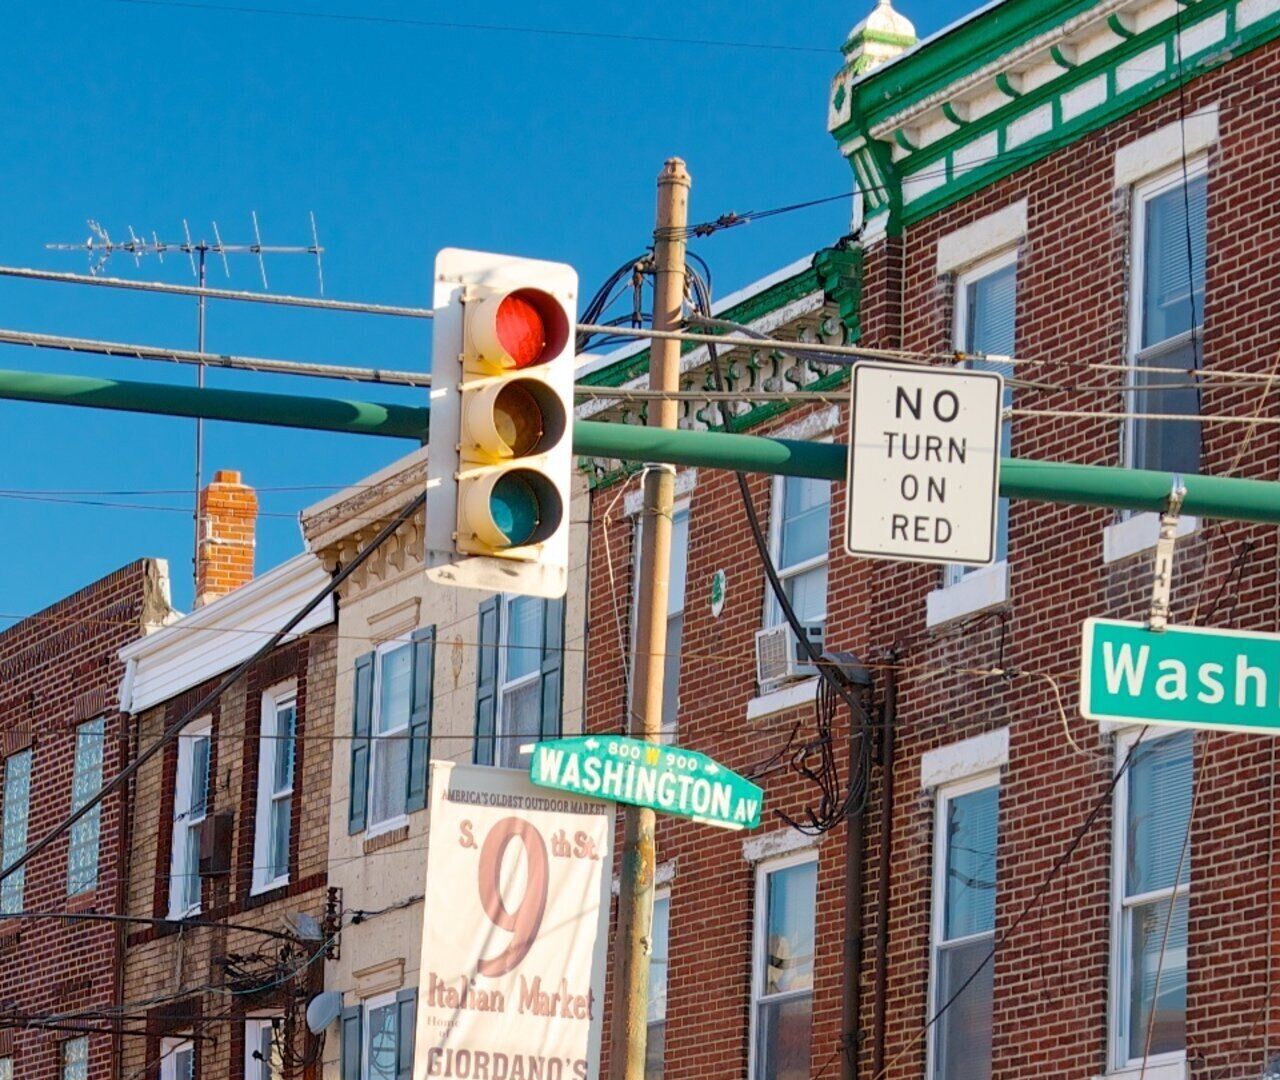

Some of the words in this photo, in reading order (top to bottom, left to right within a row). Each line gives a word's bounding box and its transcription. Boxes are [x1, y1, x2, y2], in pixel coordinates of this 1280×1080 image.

[895, 386, 960, 424] NO
[883, 431, 968, 465] TURN
[899, 473, 948, 504] ON
[891, 513, 954, 545] RED
[608, 742, 640, 759] 800
[645, 746, 661, 766] W
[666, 754, 698, 771] 900
[540, 746, 732, 819] WASHINGTON
[733, 797, 758, 822] AV
[442, 789, 489, 806] AMERICA'S
[490, 794, 522, 809] OLDEST
[525, 797, 569, 812] OUTDOOR
[570, 802, 607, 815] MARKET
[459, 819, 478, 849] S.
[573, 830, 599, 860] St.
[427, 971, 505, 1013] Italian
[518, 973, 595, 1021] Market
